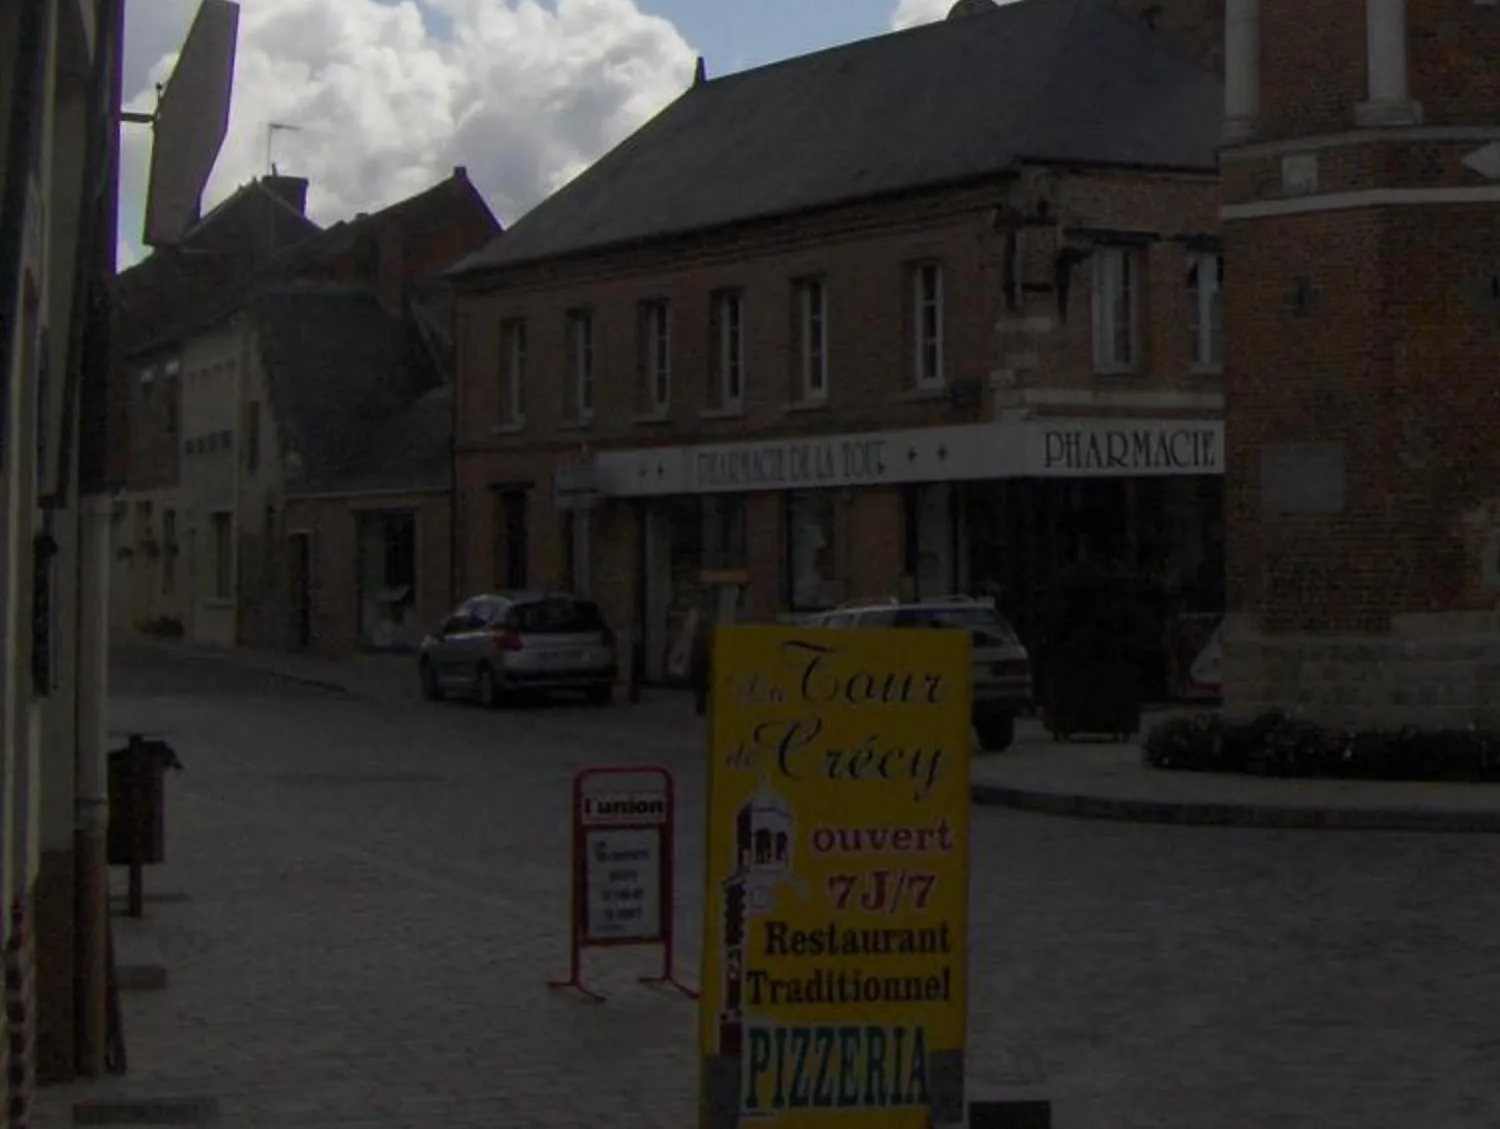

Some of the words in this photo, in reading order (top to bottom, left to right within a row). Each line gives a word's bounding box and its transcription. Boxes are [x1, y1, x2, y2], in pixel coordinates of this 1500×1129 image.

[1044, 431, 1215, 468] PHARMACIE
[780, 640, 942, 705] Tour
[753, 718, 943, 803] Crécy
[812, 820, 953, 853] ouvert
[764, 921, 951, 956] Restaurant
[746, 967, 950, 1005] Traditionnel
[745, 1026, 931, 1109] PIZZERIA
